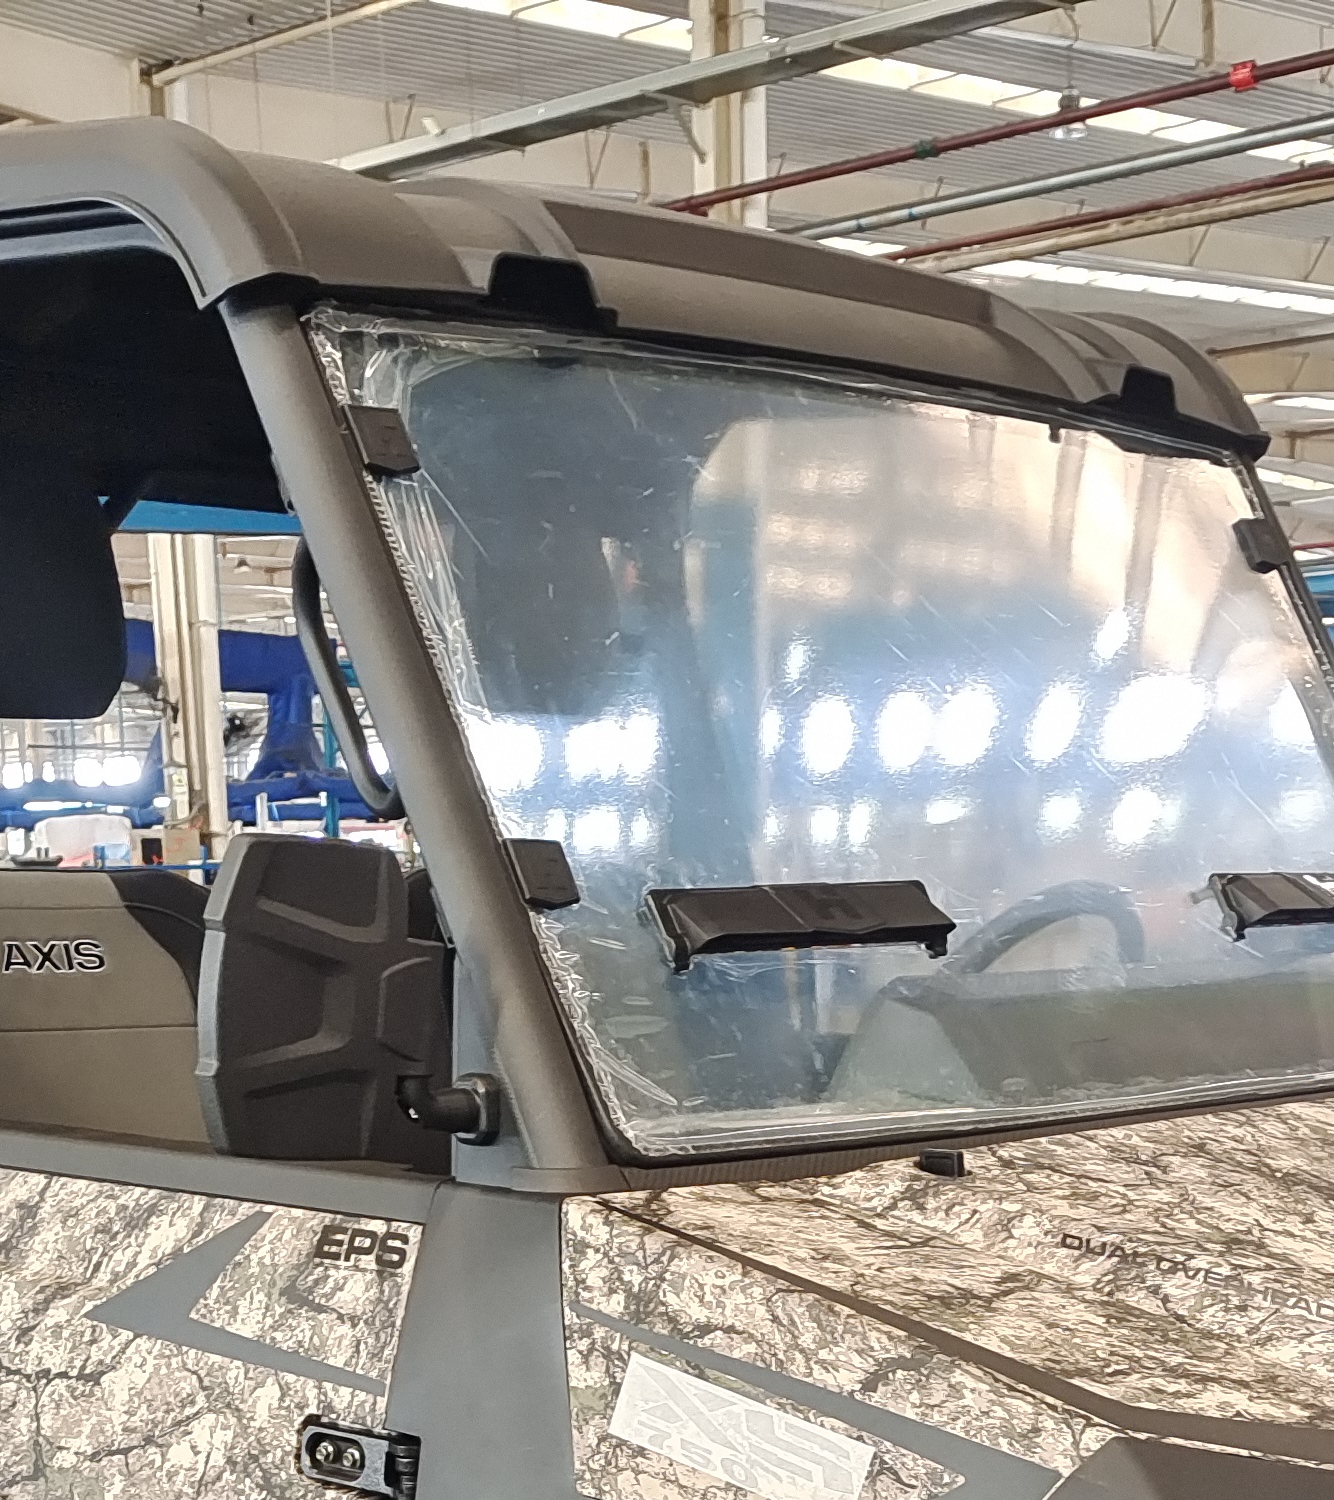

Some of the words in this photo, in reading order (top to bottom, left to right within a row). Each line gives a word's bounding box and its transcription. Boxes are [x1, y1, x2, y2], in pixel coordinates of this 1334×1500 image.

[1, 938, 107, 974] AXIS
[313, 1223, 410, 1270] EPS
[637, 1418, 759, 1489] 750
